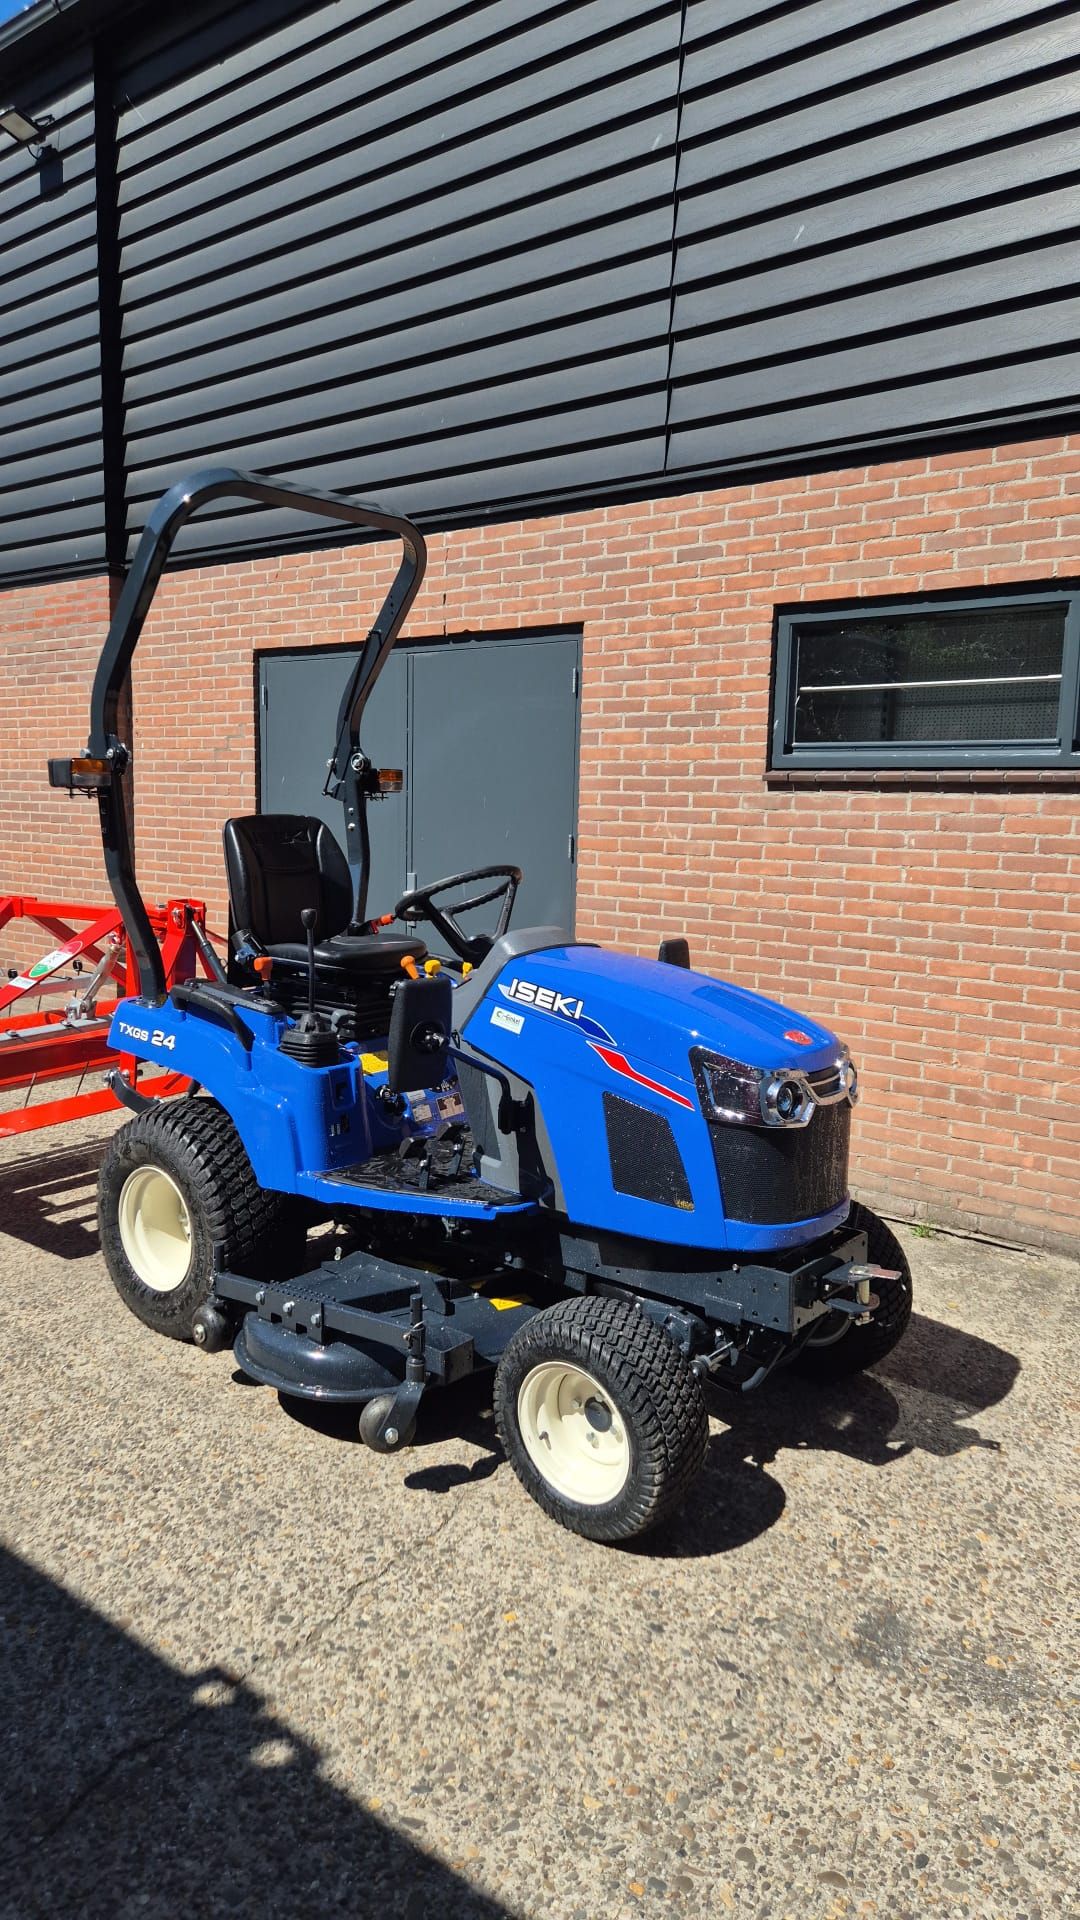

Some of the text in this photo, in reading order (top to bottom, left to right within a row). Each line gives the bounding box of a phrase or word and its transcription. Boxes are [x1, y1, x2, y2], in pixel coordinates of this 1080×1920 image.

[509, 978, 584, 1019] ISEKI
[119, 1022, 176, 1050] TXGS 24
